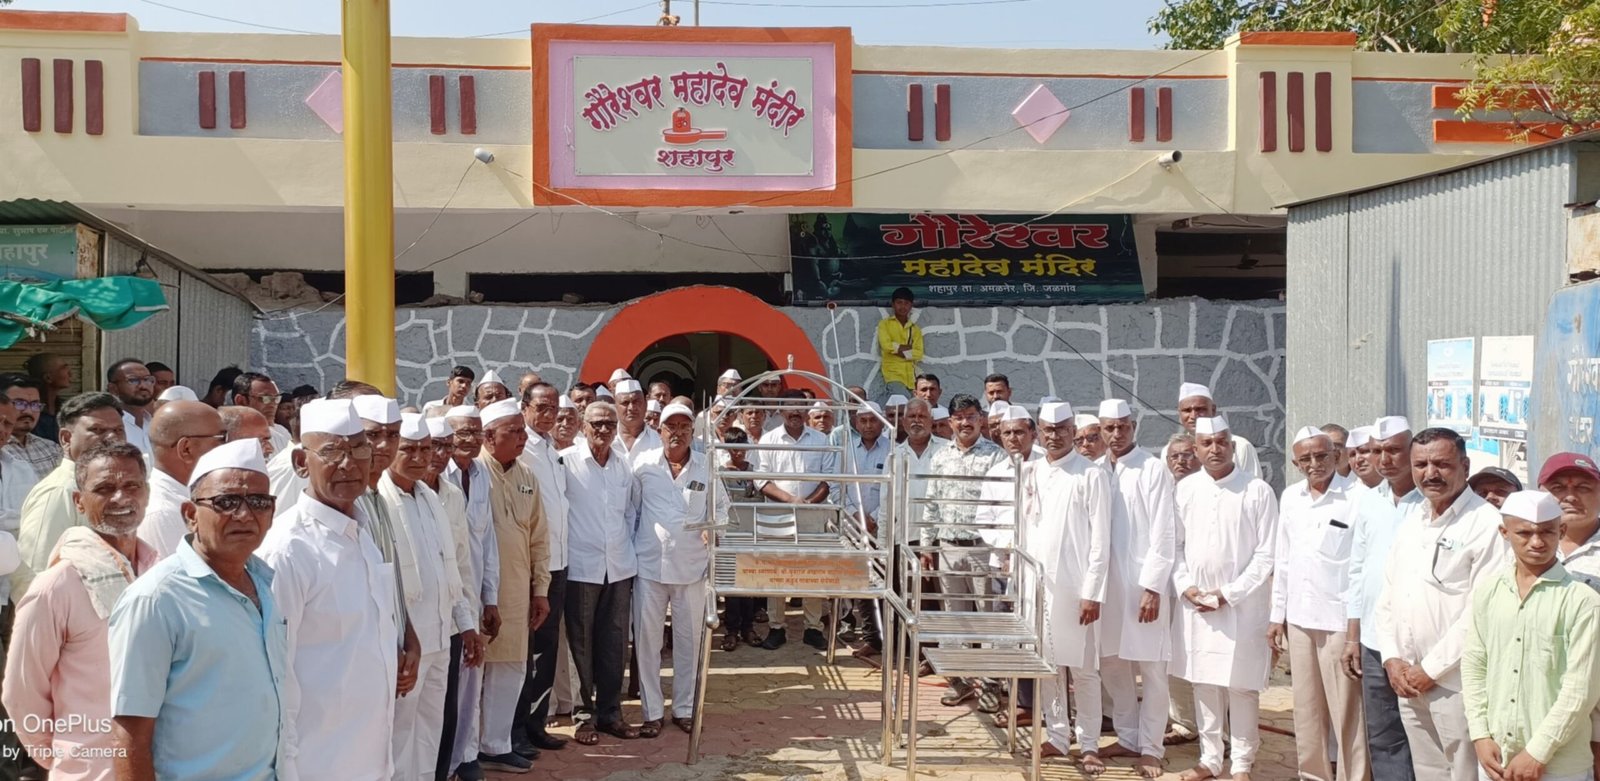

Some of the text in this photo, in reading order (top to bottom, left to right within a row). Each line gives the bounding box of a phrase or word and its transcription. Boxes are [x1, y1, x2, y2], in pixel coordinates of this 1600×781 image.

[582, 62, 806, 137] गौरेश्वर महादेव मंदीर
[656, 148, 735, 173] शहापुर
[880, 213, 1109, 249] गौरेश्वर
[902, 253, 1098, 277] महादेव मंदिर
[928, 284, 958, 295] शहापुर
[961, 284, 976, 293] ता.
[1023, 282, 1039, 293] जि.
